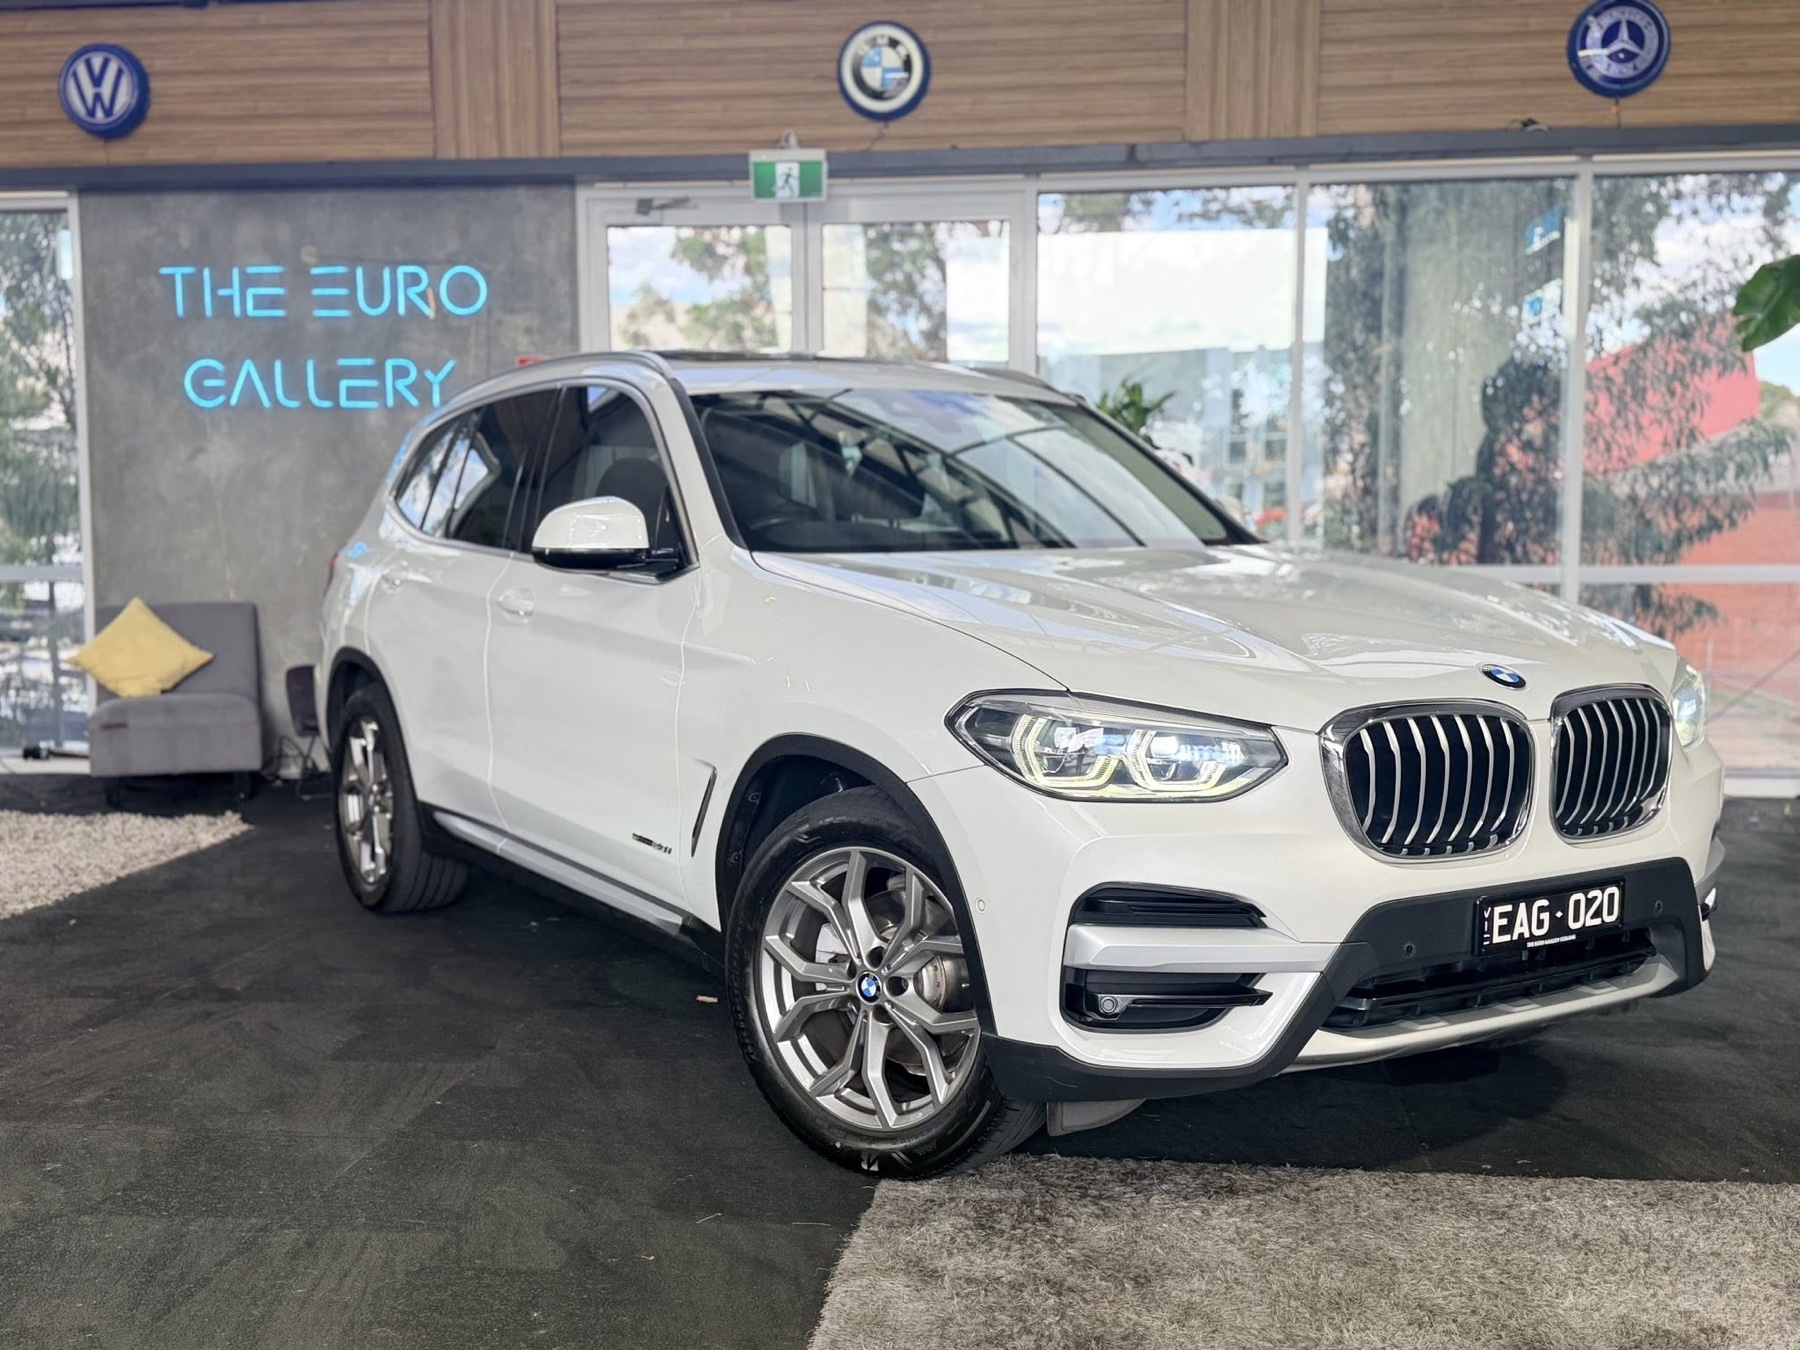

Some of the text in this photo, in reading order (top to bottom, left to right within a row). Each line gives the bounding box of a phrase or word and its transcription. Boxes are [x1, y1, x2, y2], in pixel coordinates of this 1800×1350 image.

[158, 264, 488, 319] THE EURO
[183, 358, 458, 409] GALLERY
